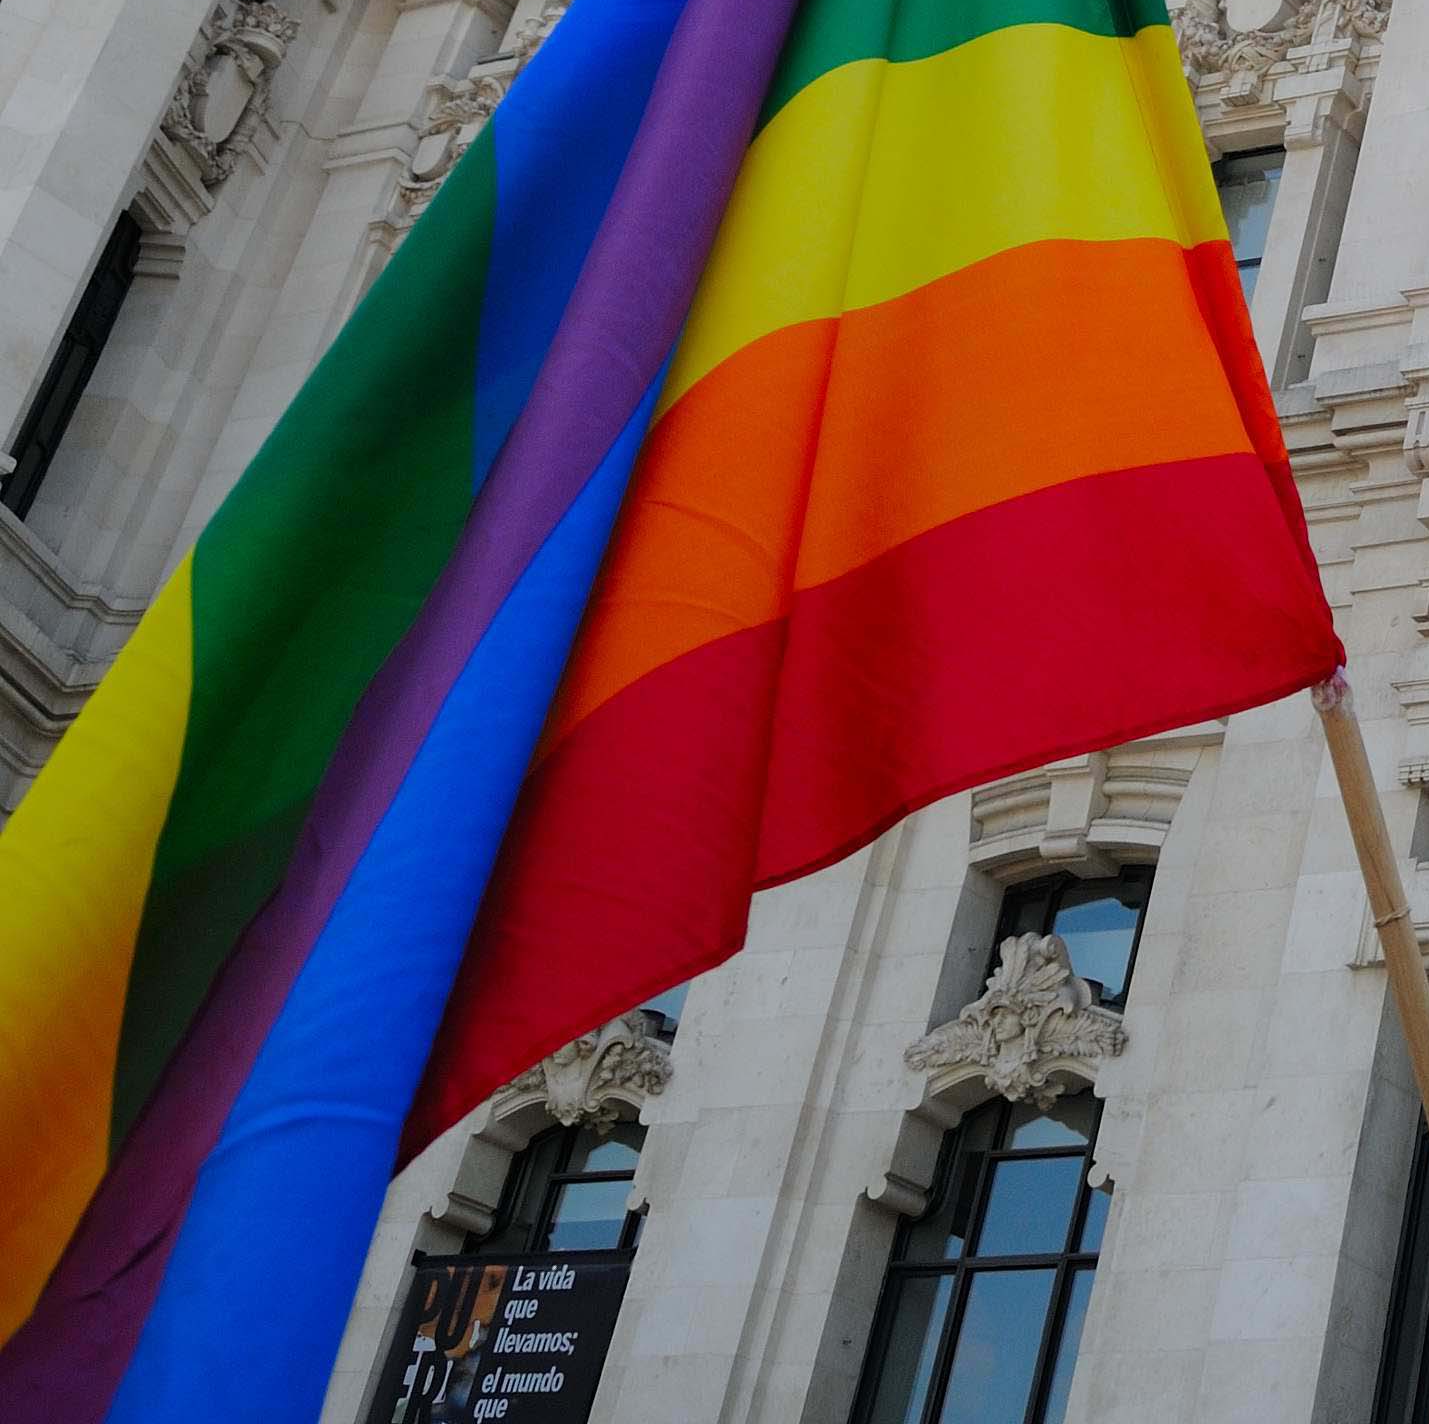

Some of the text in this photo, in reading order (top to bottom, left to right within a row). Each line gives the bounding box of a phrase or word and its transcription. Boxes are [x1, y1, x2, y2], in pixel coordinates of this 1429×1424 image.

[511, 1263, 576, 1292] La vida
[503, 1297, 539, 1325] que
[493, 1326, 579, 1356] llevamos;
[481, 1365, 503, 1394] el
[501, 1364, 565, 1394] mundo
[473, 1396, 510, 1424] que
